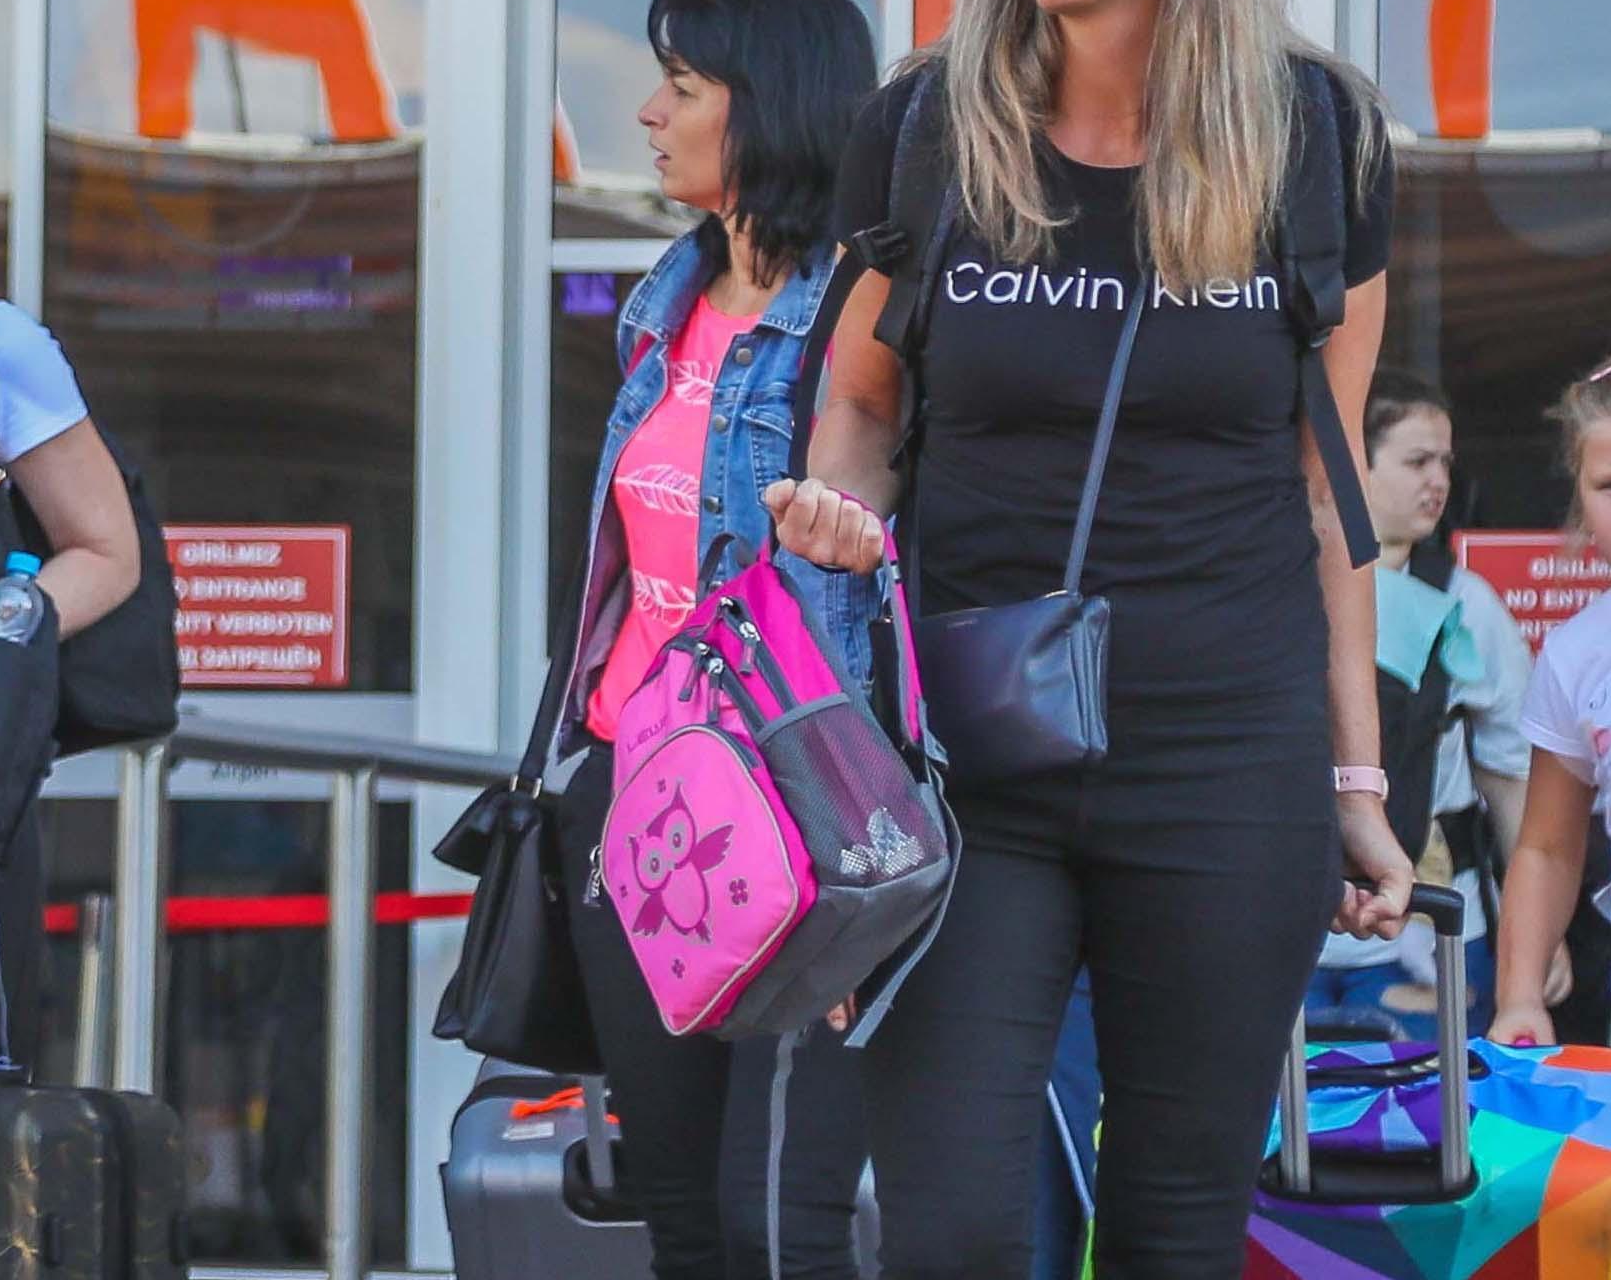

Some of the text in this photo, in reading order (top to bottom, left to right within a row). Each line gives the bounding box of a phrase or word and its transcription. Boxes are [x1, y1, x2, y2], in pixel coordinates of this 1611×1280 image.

[946, 261, 1124, 311] Calvin
[192, 577, 307, 601] ENTRANCE
[1506, 588, 1539, 611] NO
